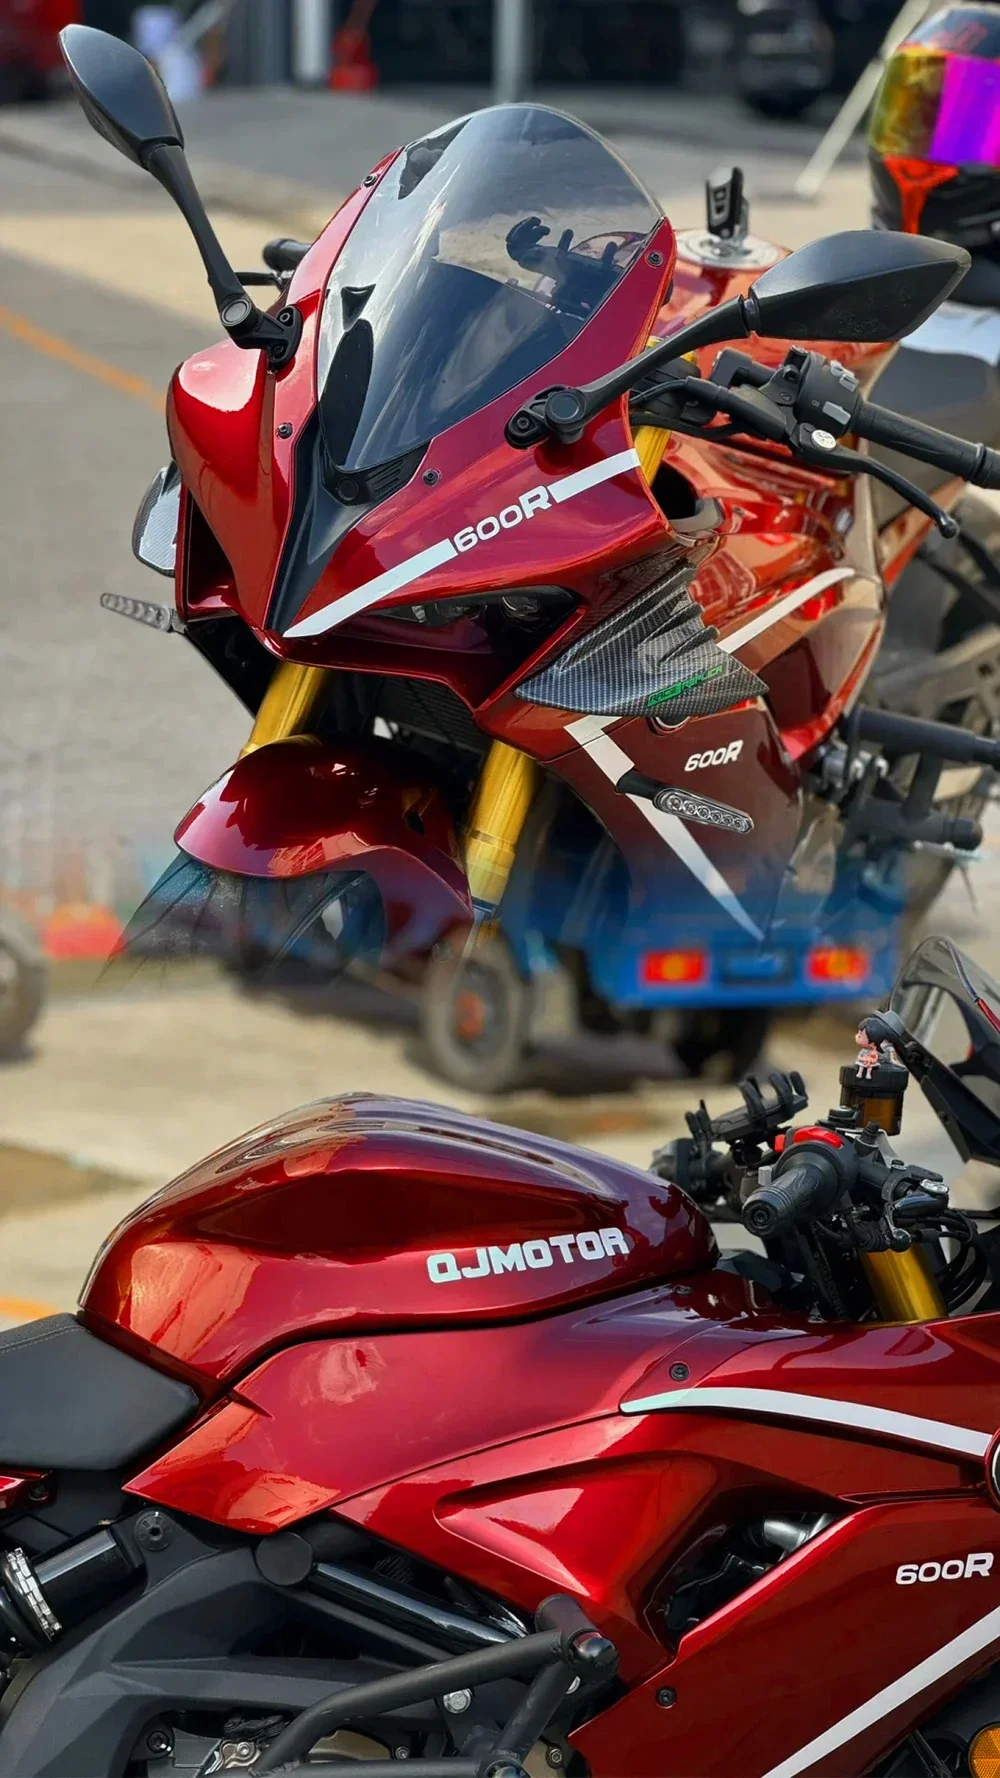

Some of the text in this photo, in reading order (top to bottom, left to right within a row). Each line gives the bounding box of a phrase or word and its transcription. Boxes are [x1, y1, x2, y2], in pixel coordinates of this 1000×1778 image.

[453, 485, 552, 552] 600R
[684, 740, 743, 772] 600R
[427, 1227, 630, 1283] QJMOTOR
[896, 1552, 994, 1587] 600R
